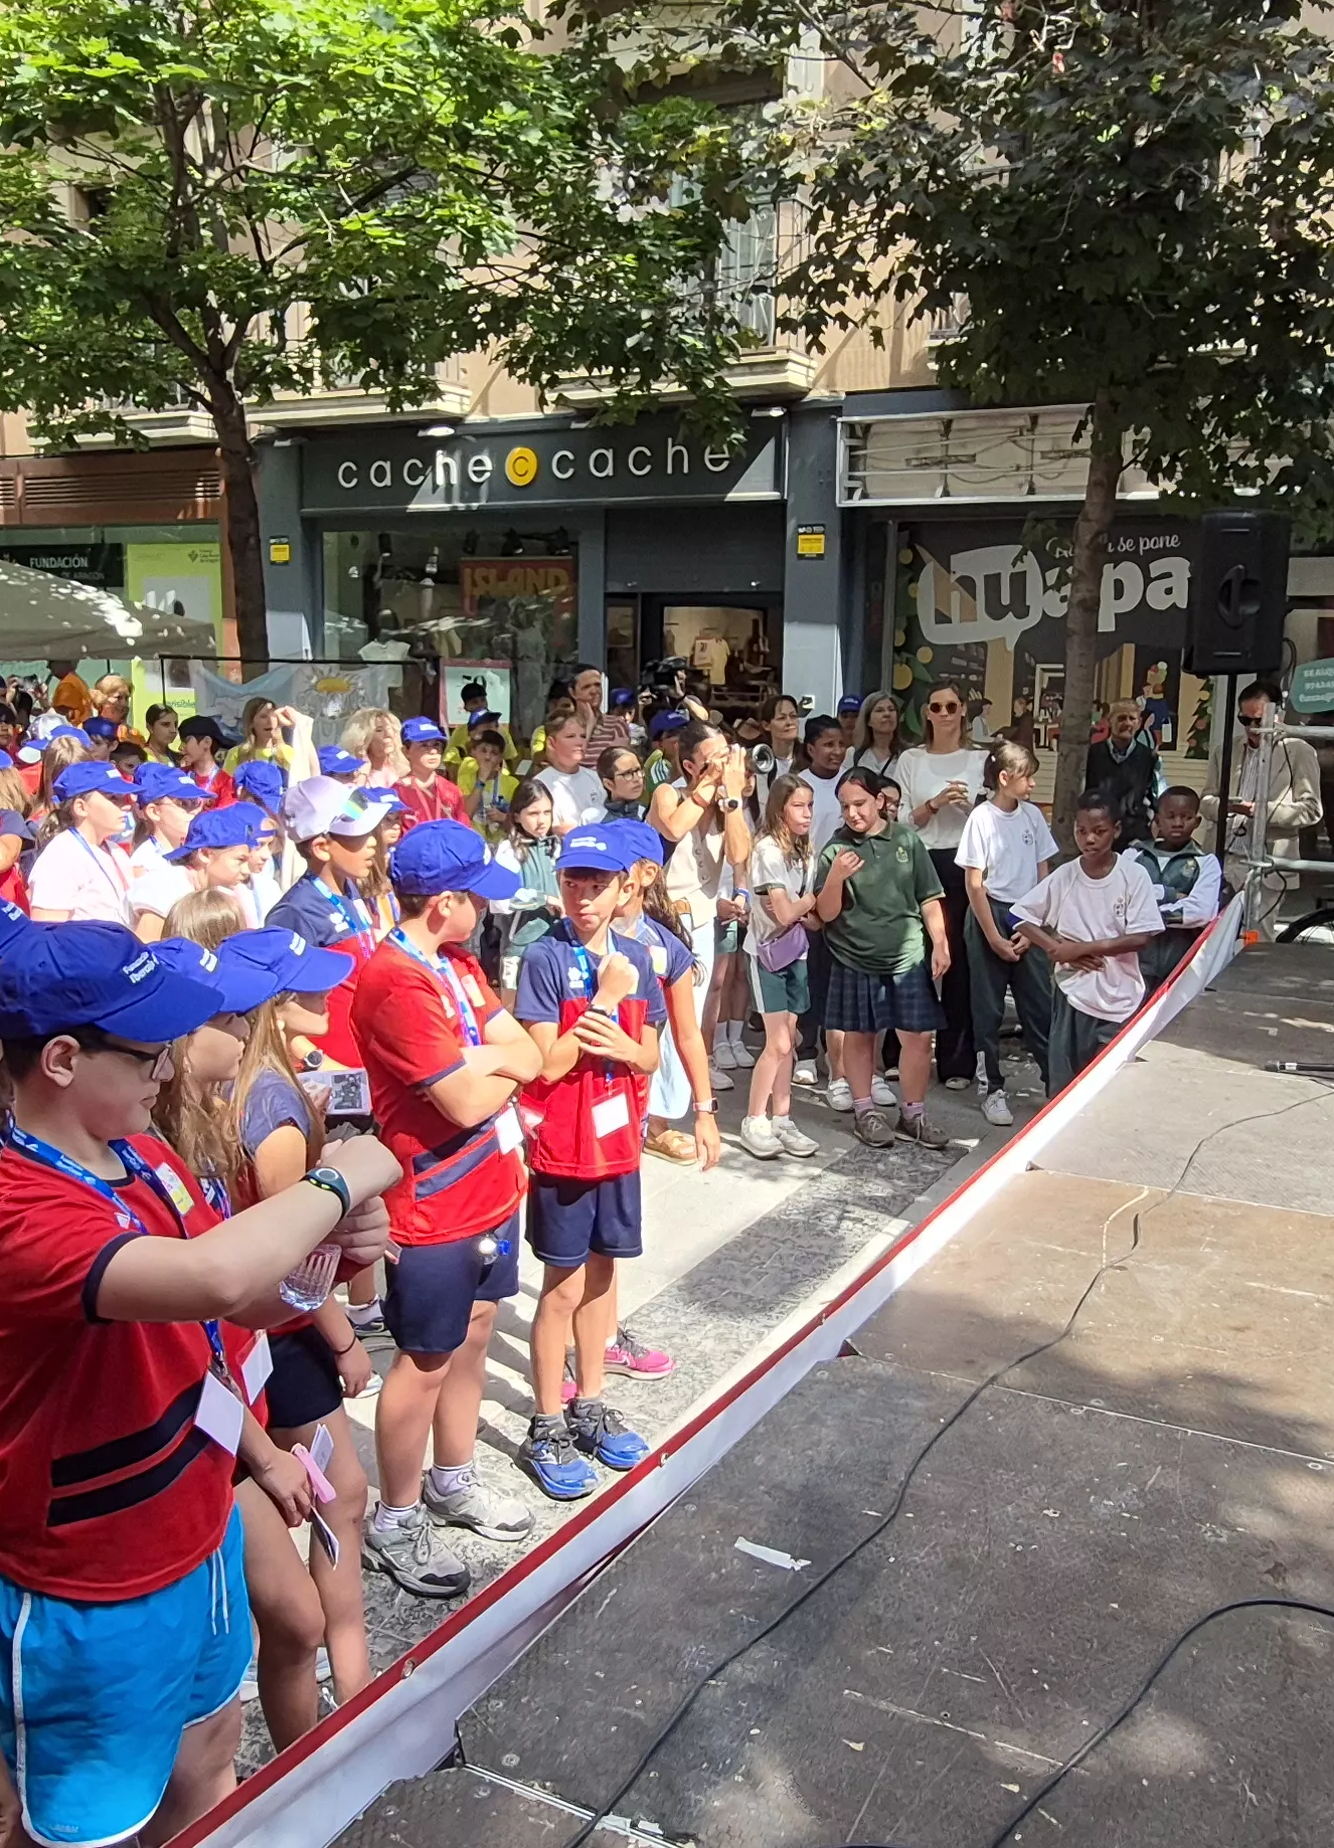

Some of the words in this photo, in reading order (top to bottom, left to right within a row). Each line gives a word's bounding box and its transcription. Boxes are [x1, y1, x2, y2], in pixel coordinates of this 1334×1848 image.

[337, 448, 493, 489] cache
[551, 436, 731, 480] cache
[1139, 534, 1182, 556] pone
[29, 553, 89, 569] FUNDACIÓN
